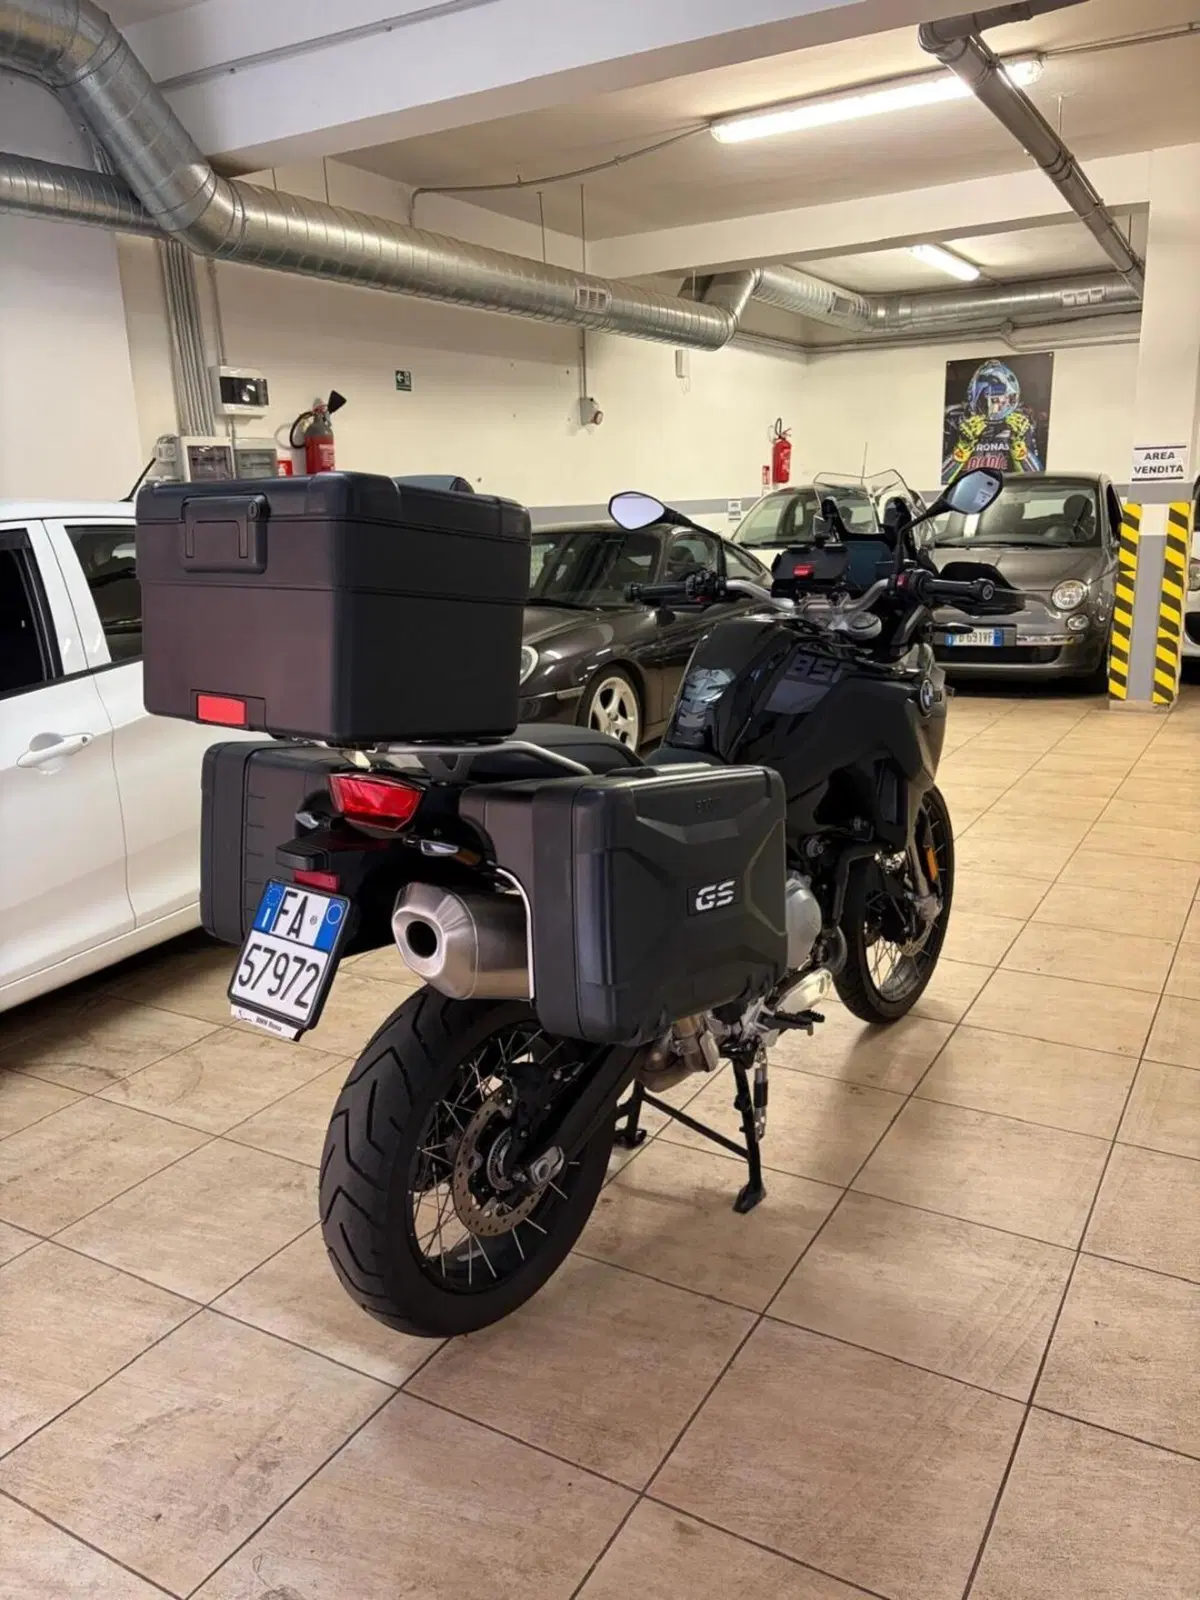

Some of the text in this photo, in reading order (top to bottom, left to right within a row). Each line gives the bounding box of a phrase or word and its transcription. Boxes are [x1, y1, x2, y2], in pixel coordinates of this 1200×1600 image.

[1134, 464, 1184, 475] VENDITA
[1144, 451, 1176, 461] AREA
[695, 880, 736, 911] GS
[272, 890, 309, 939] FA
[238, 943, 320, 1009] 57972
